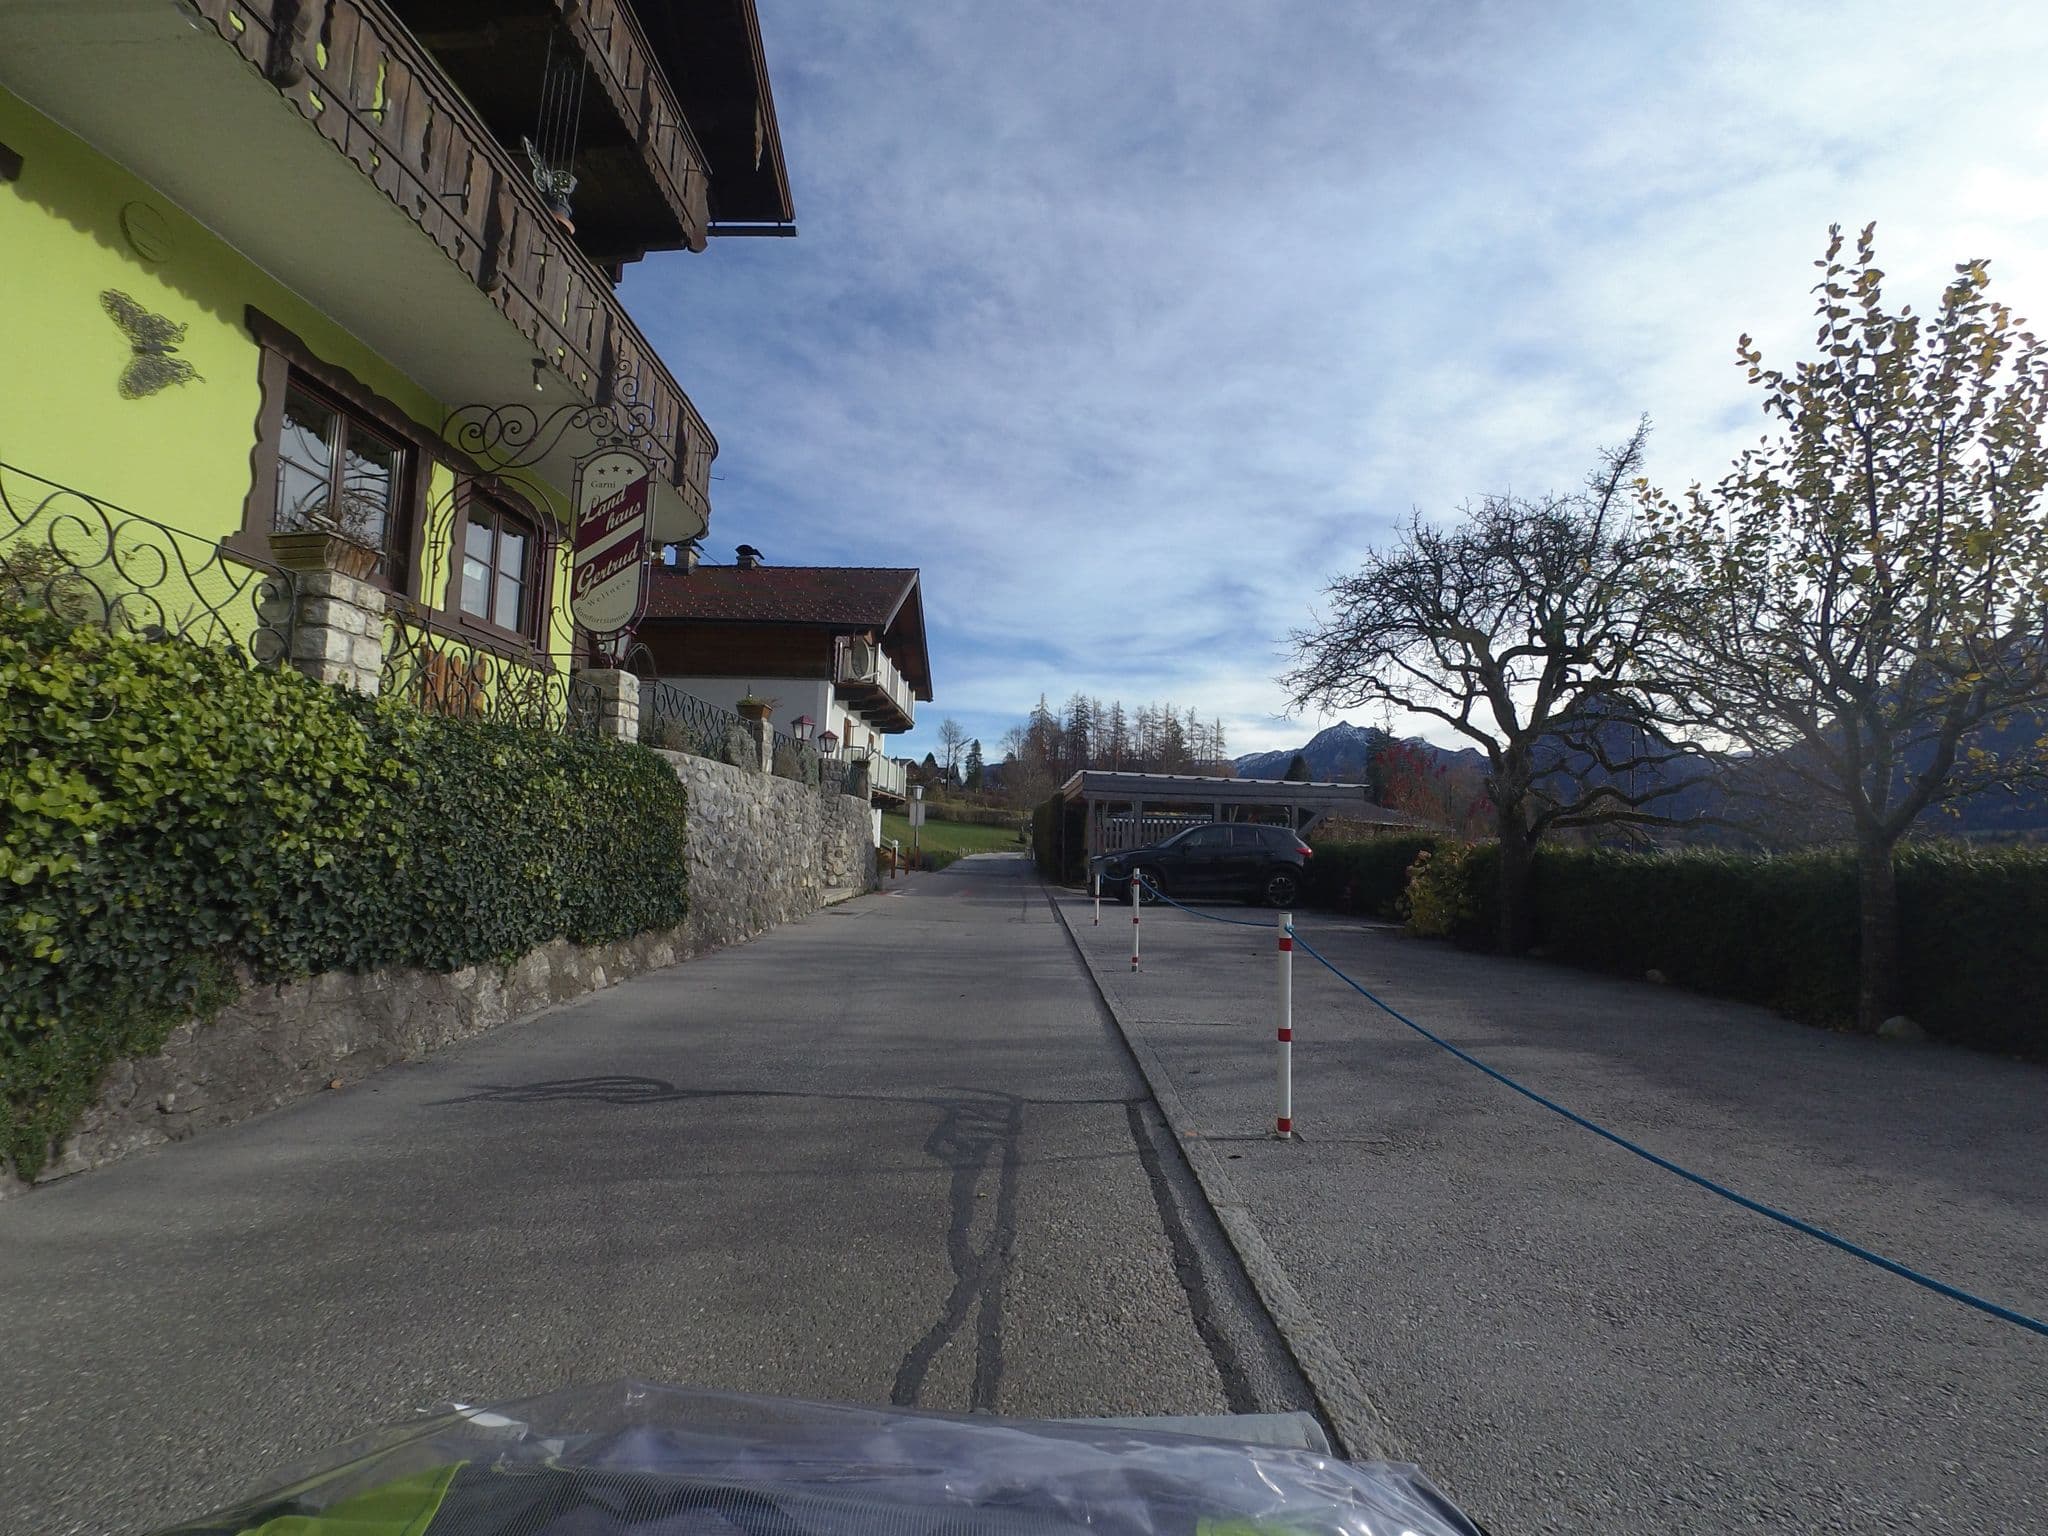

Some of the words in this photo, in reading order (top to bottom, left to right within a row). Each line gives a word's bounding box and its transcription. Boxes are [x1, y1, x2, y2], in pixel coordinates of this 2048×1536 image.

[590, 481, 616, 489] Garni
[580, 484, 628, 528] Land
[606, 502, 641, 532] haus
[576, 541, 639, 601] Gertrud
